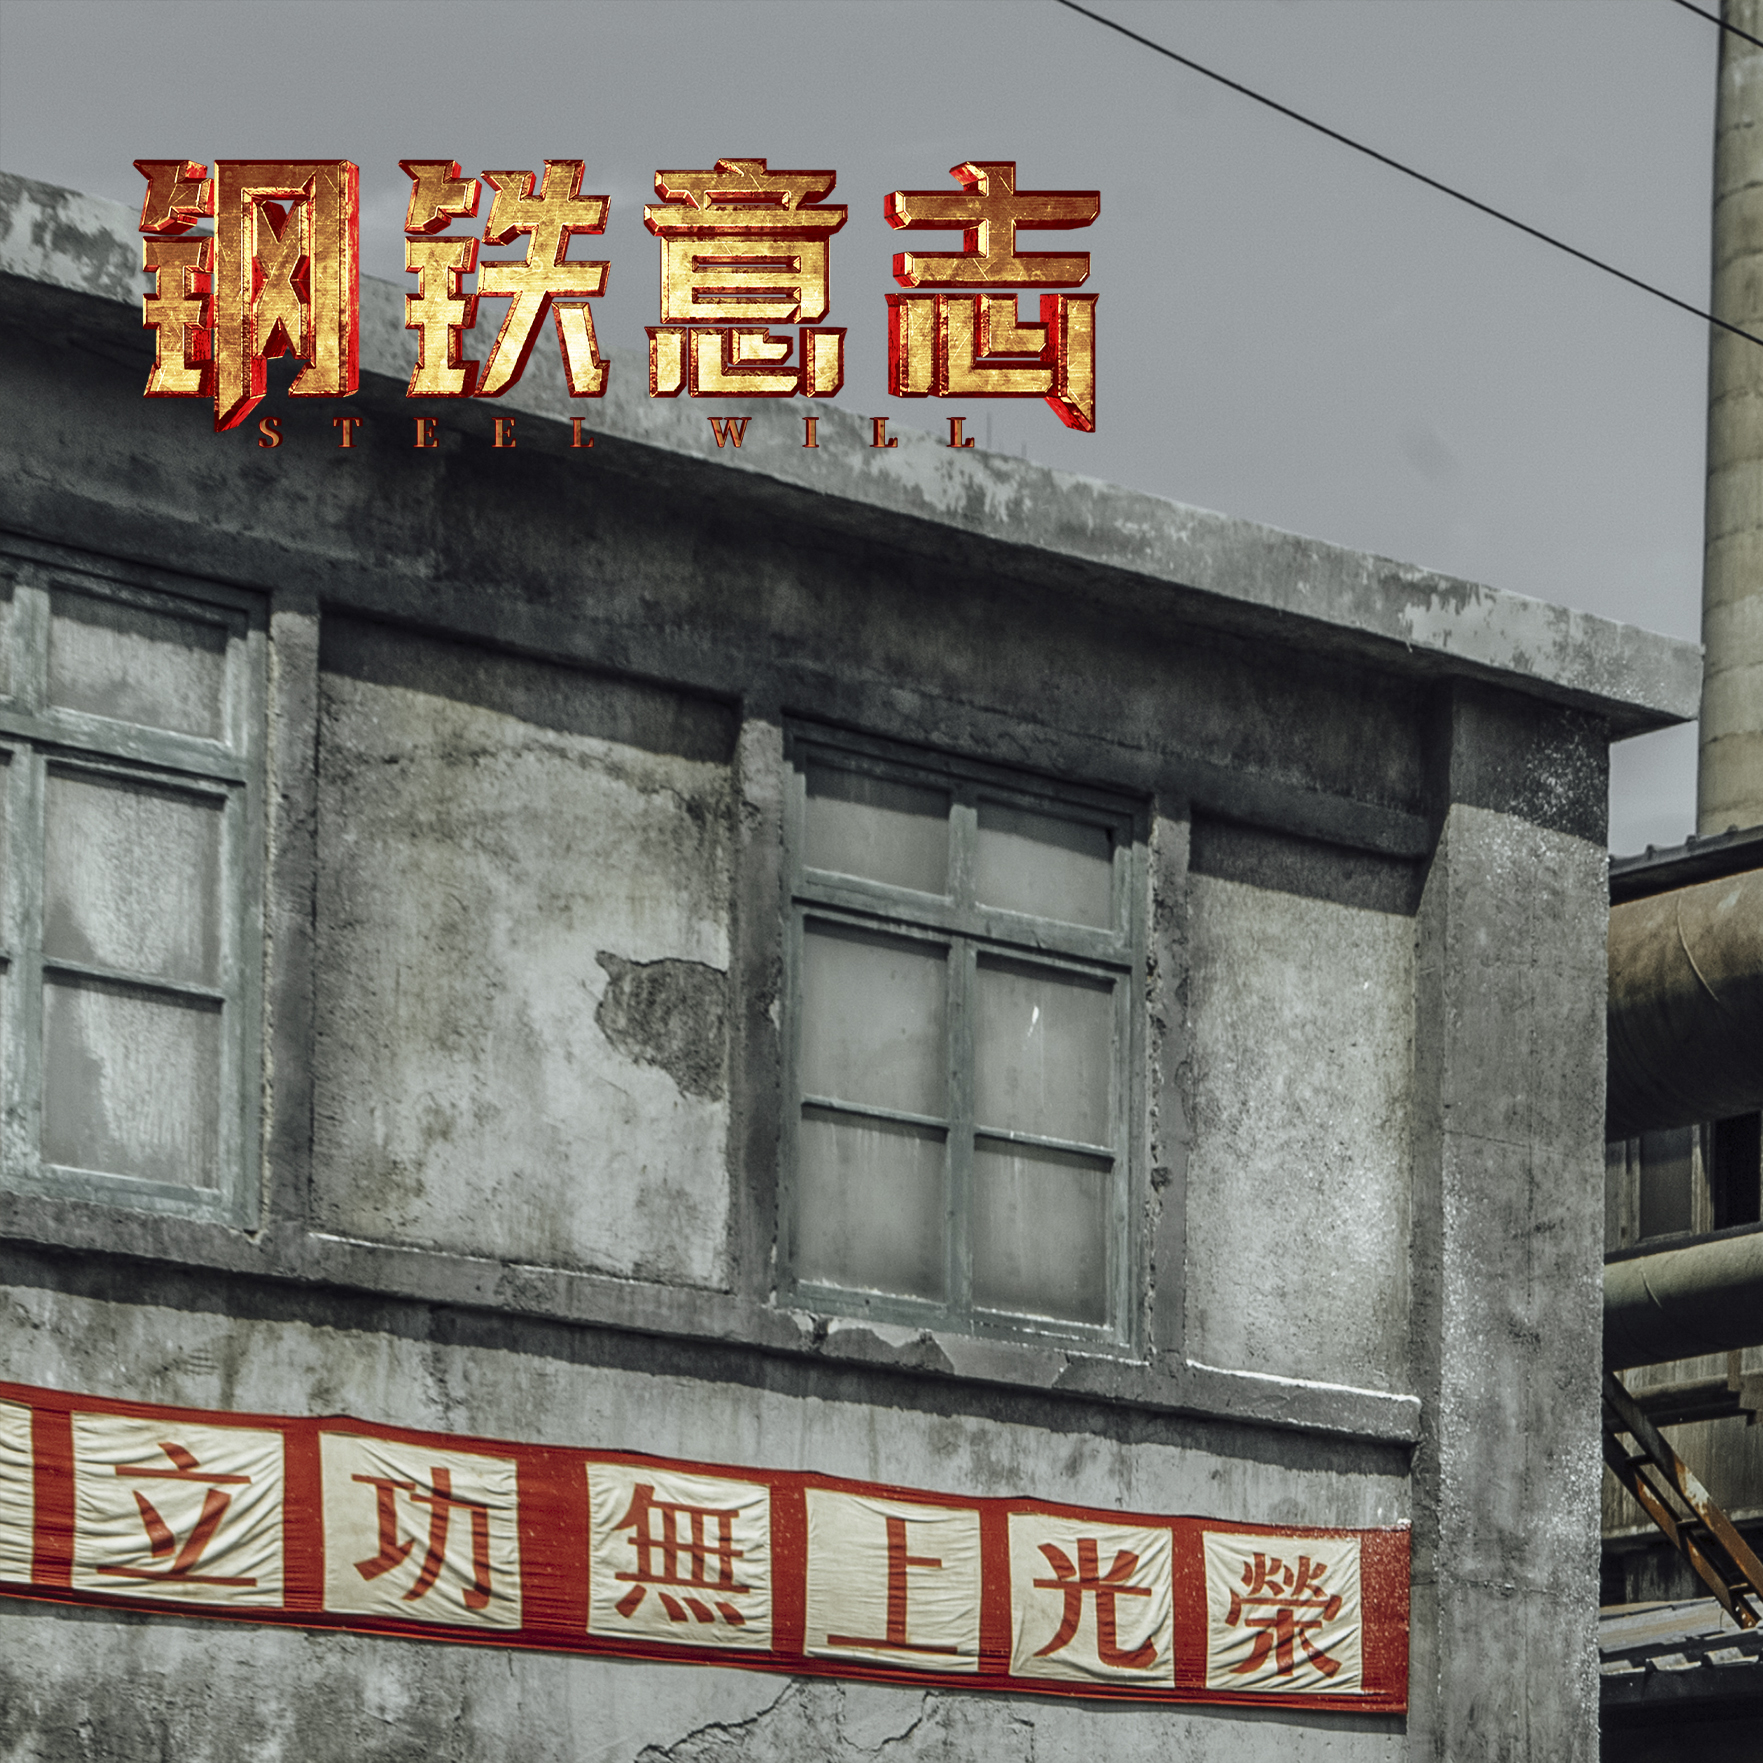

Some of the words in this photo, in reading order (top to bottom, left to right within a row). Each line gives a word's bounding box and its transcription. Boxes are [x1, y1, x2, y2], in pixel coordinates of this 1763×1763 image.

[96, 1441, 1342, 1675] 立功無上光榮
